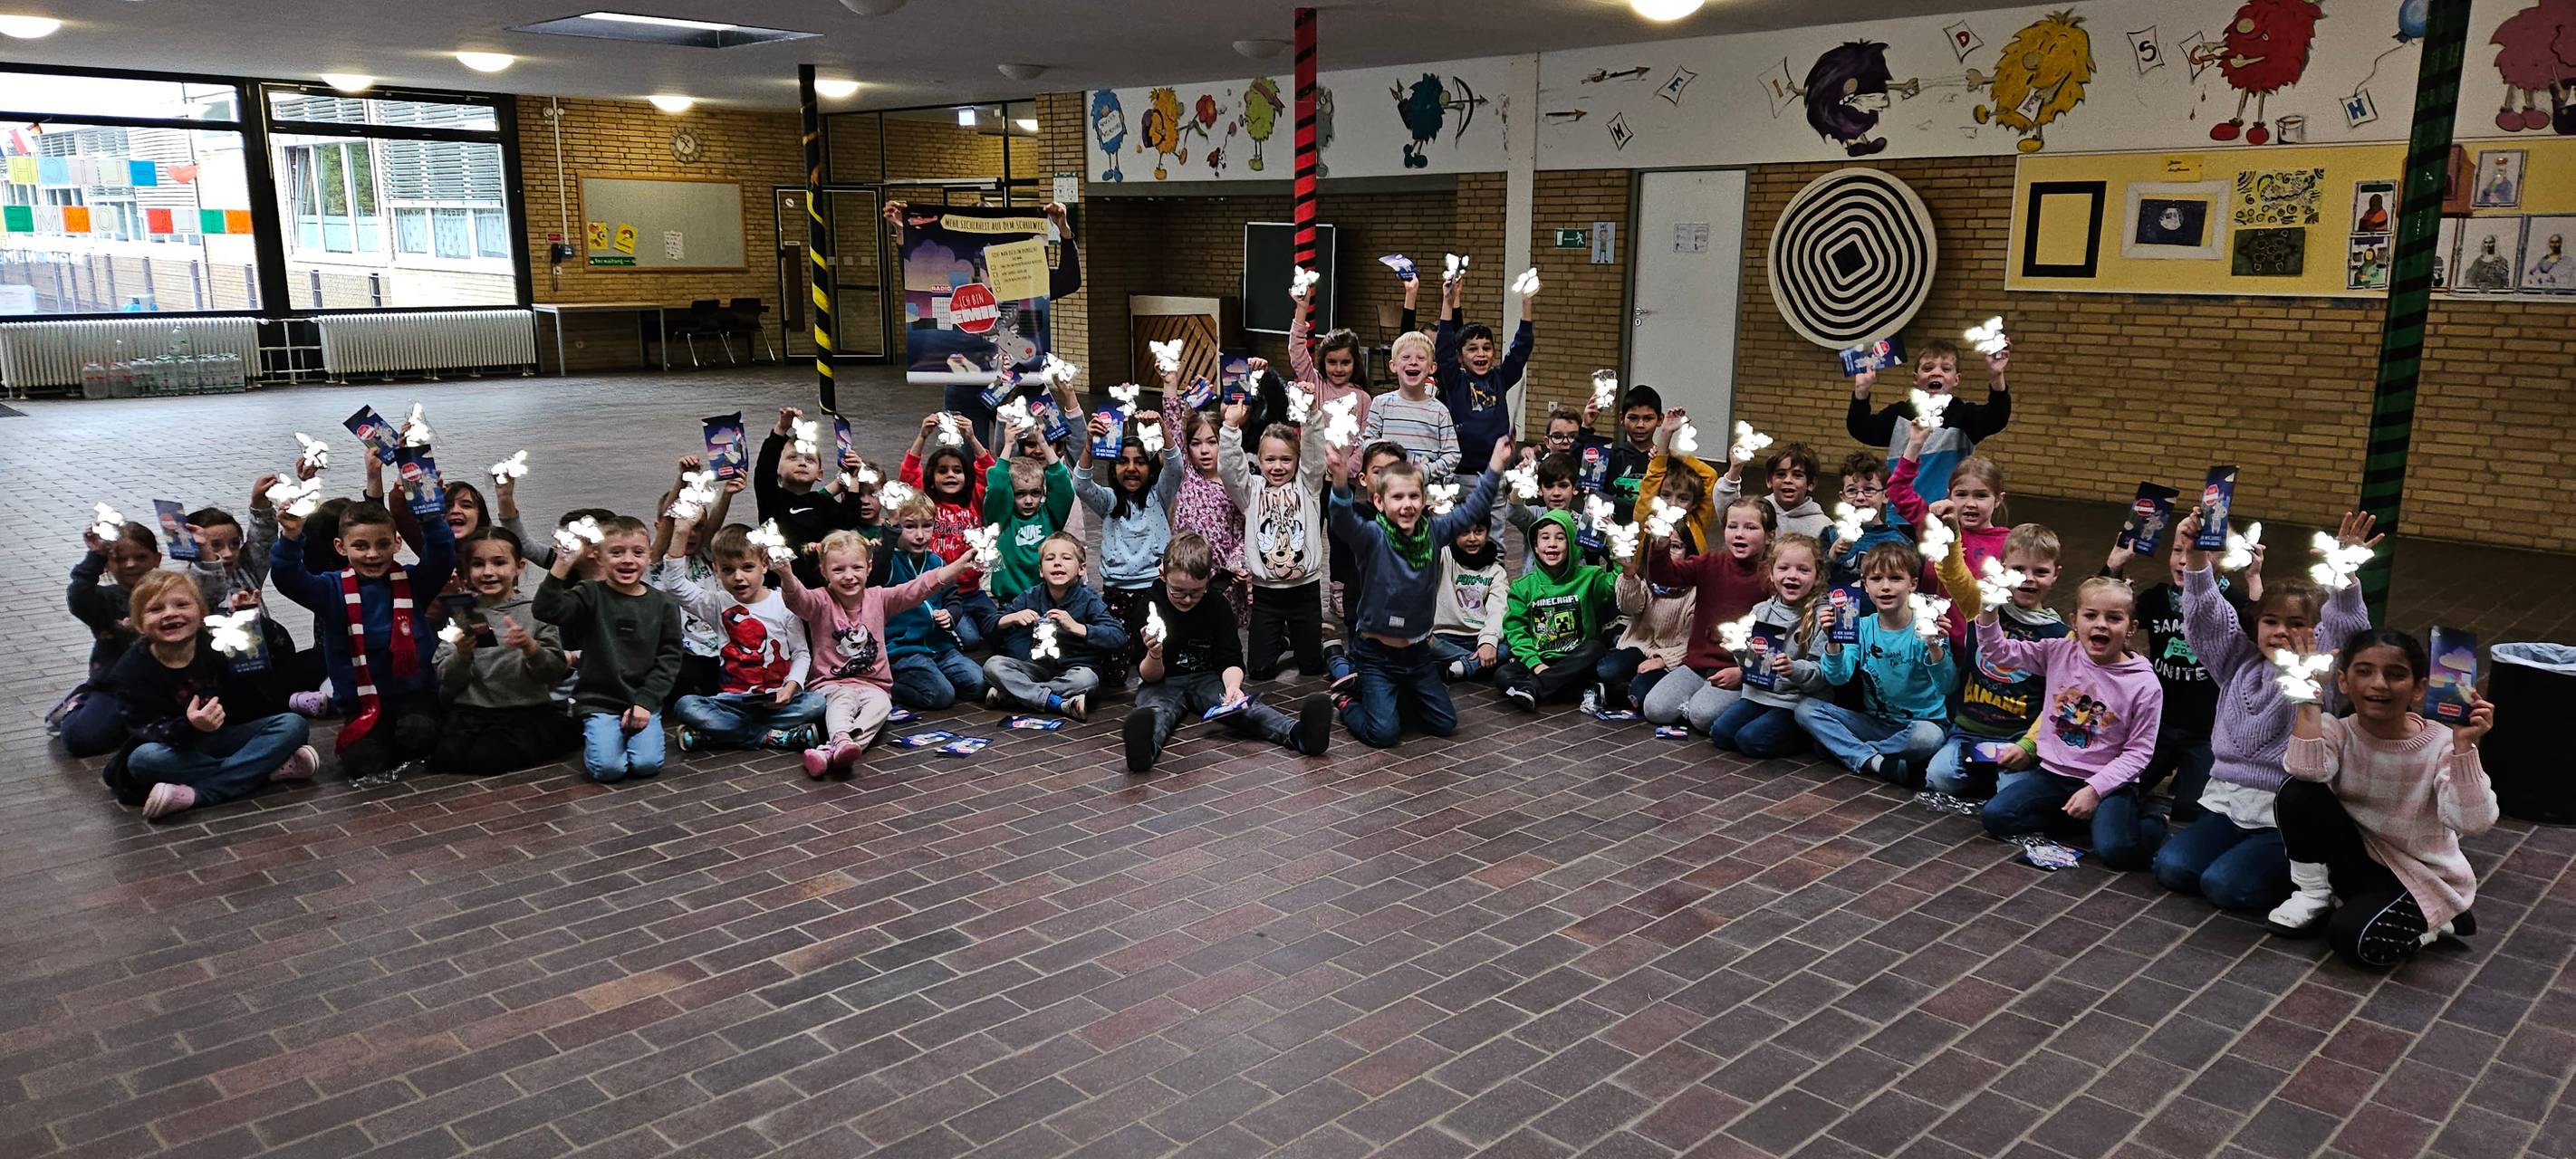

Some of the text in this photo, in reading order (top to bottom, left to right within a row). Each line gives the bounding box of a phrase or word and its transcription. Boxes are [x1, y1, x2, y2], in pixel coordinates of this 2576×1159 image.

[1956, 31, 1971, 48] D
[2139, 40, 2157, 62] S
[2347, 98, 2367, 120] H
[945, 218, 1044, 231] MEHR SICHERHEIT AUF DEM SCHULWEG
[958, 293, 985, 307] ICH BIN
[950, 304, 1001, 324] EMIL
[1018, 524, 1043, 541] NIKE
[1532, 594, 1580, 608] MINECRAFT
[2155, 657, 2209, 681] UNITE
